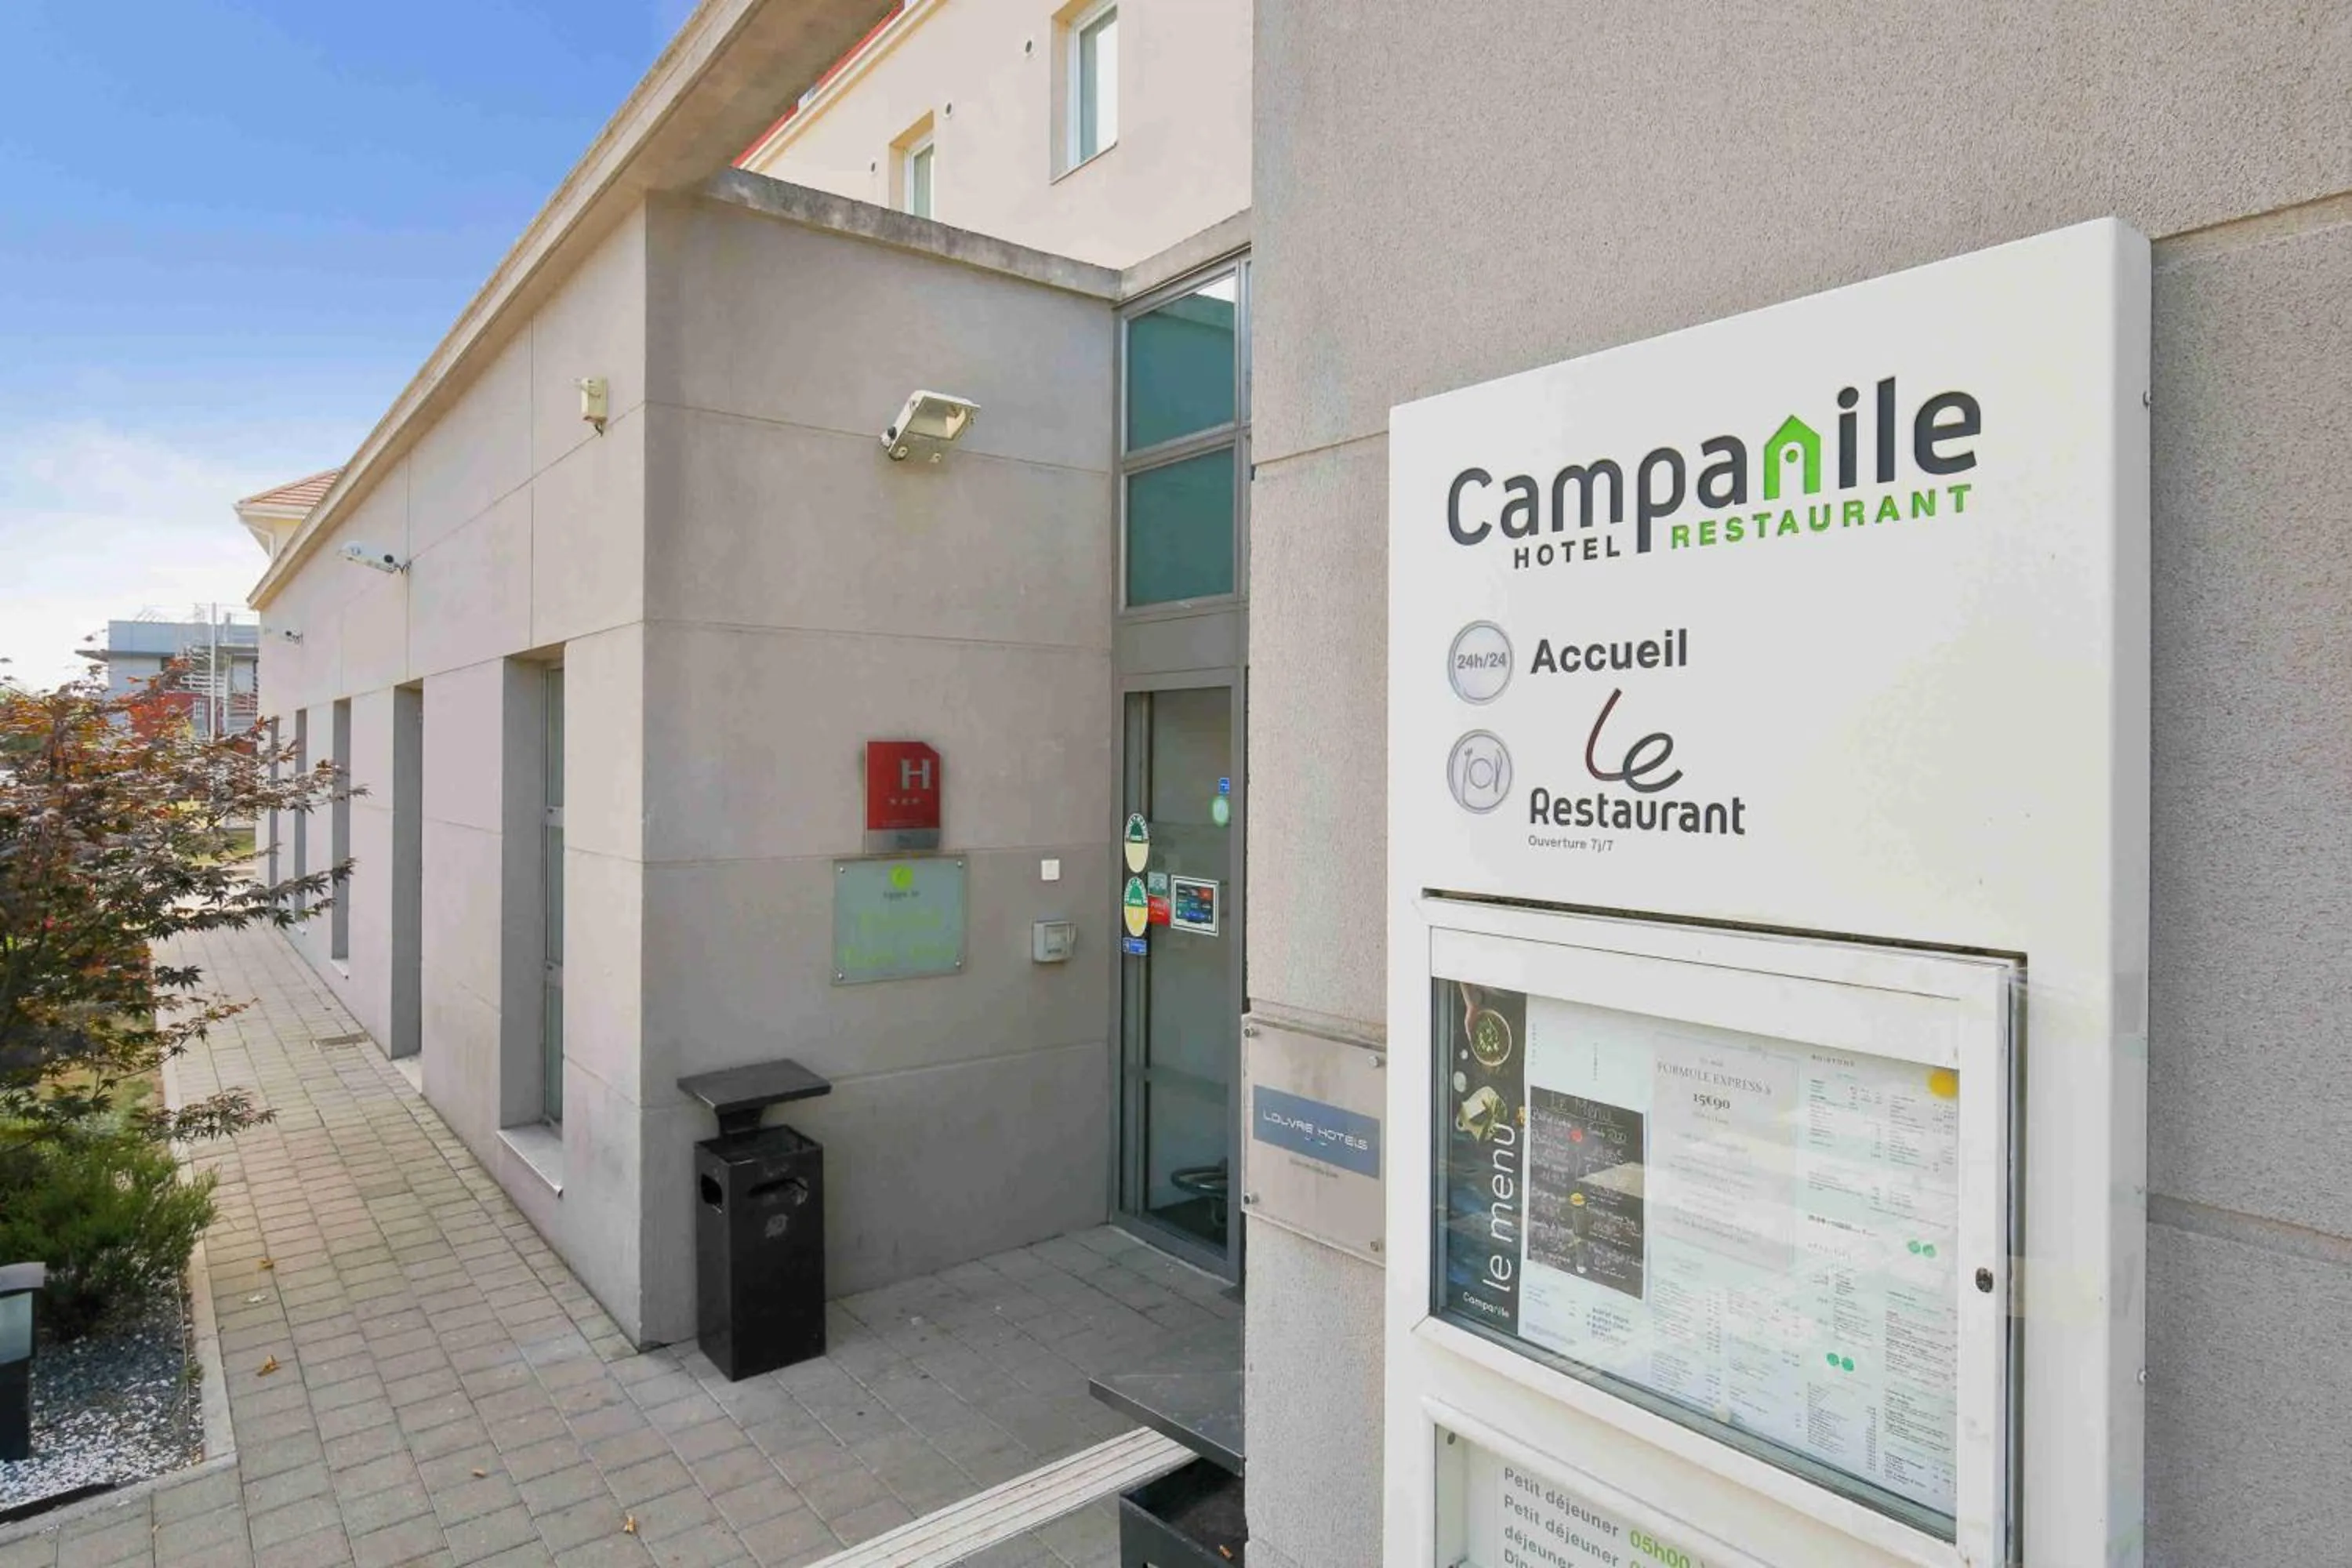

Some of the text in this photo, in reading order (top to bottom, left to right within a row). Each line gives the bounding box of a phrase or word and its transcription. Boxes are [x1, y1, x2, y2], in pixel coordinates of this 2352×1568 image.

[1447, 376, 1982, 554] Campanile
[1514, 484, 1973, 569] HOTEL RESTAURANT
[1457, 652, 1507, 670] 24h/24
[1530, 629, 1687, 674] Accueil
[1585, 688, 1683, 793] Le
[901, 758, 931, 790] H
[1530, 786, 1746, 836] Restaurant
[1528, 834, 1613, 854] Ouverture 7j/7
[1483, 1122, 1516, 1292] le menu
[1504, 1467, 1541, 1497] Petit
[1545, 1490, 1619, 1537] déjeuner
[1504, 1494, 1619, 1567] Petit déjeuner
[1504, 1526, 1575, 1568] déjeuner
